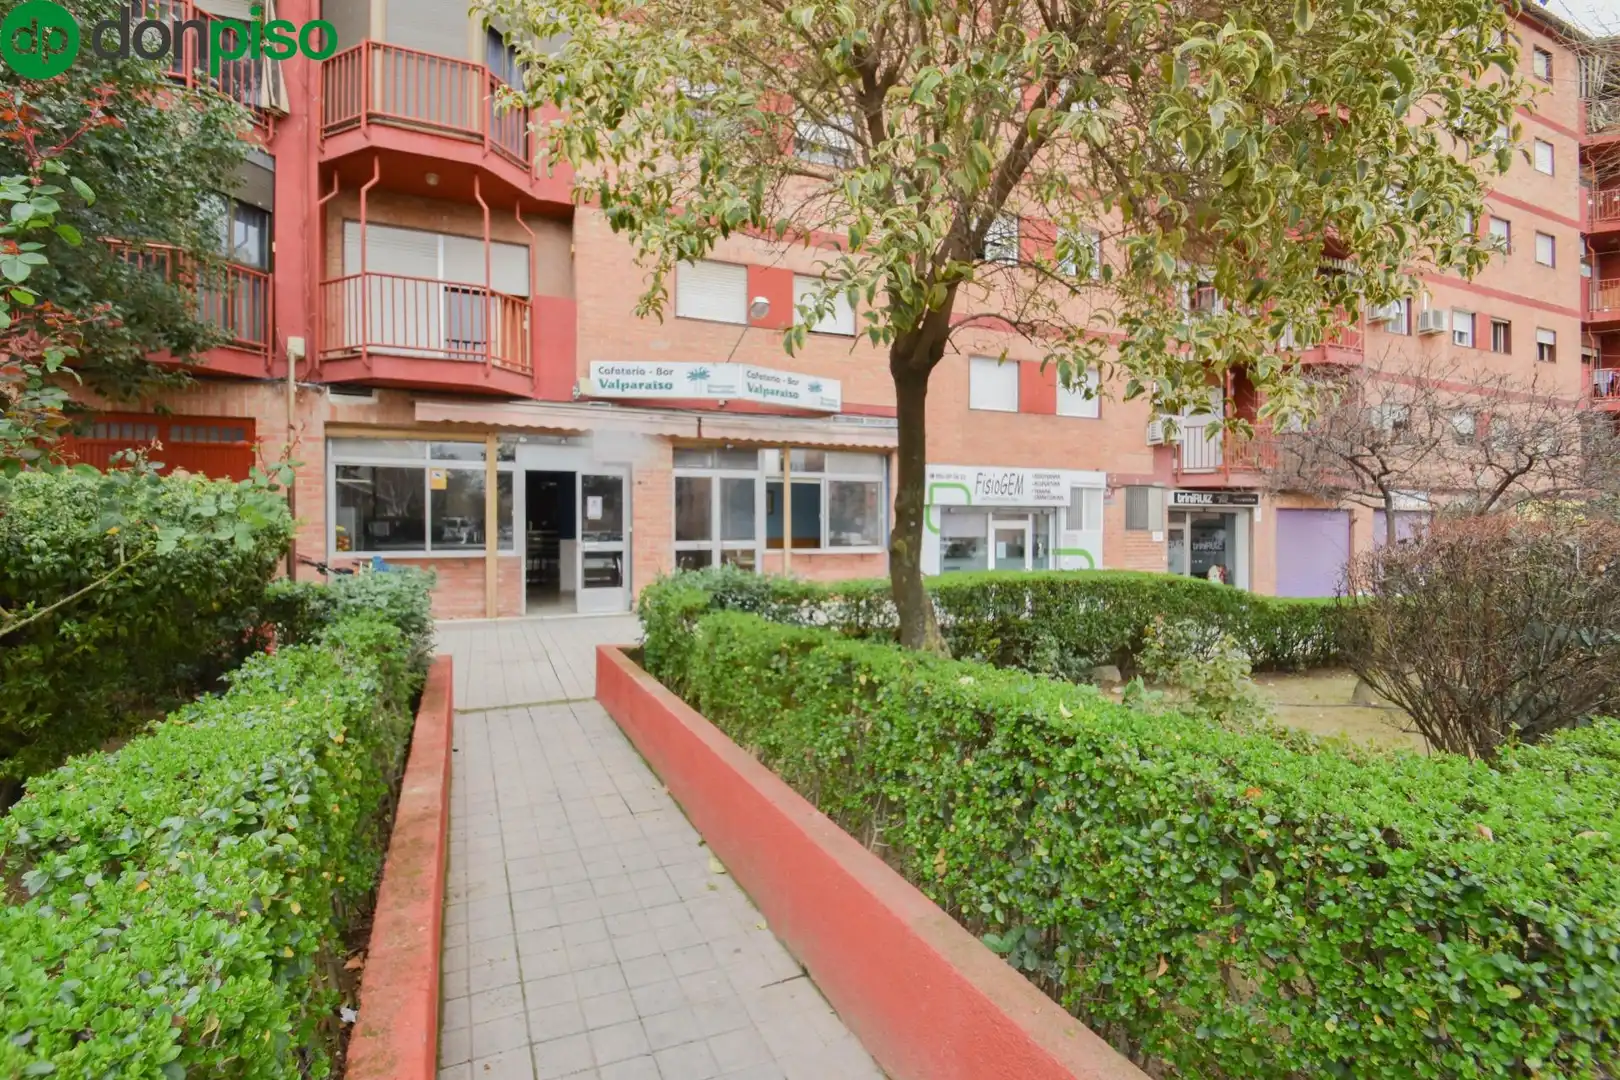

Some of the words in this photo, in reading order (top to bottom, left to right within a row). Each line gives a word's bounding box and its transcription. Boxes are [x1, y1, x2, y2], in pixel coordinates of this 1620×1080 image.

[656, 367, 674, 376] Bar
[598, 379, 674, 392] Valparaiso
[746, 382, 800, 399] Valparaiso
[975, 472, 1024, 496] FisioGEM
